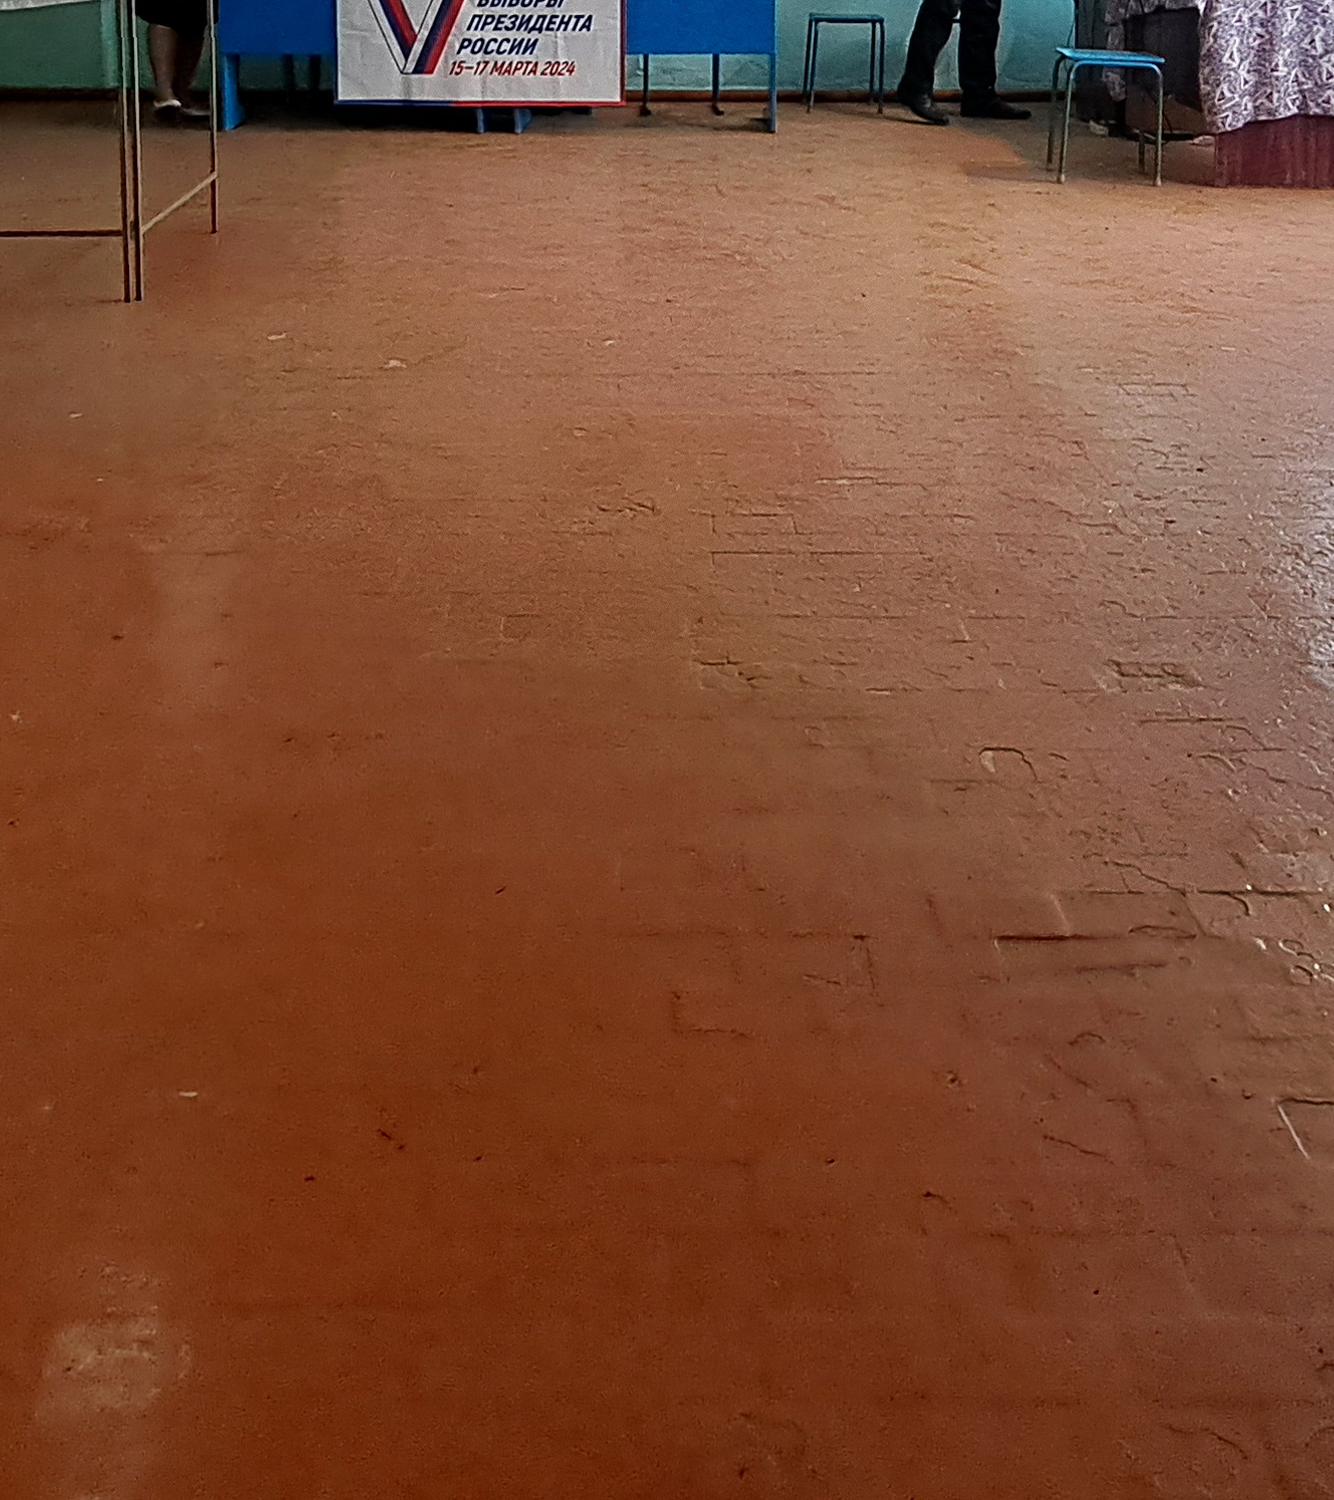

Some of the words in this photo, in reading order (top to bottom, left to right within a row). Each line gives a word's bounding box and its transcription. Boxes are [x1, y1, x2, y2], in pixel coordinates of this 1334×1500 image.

[466, 14, 593, 34] ПРЕЗИДЕНТА
[456, 38, 539, 55] РОССИИ
[489, 61, 538, 76] МАРТА
[540, 61, 576, 76] 2024
